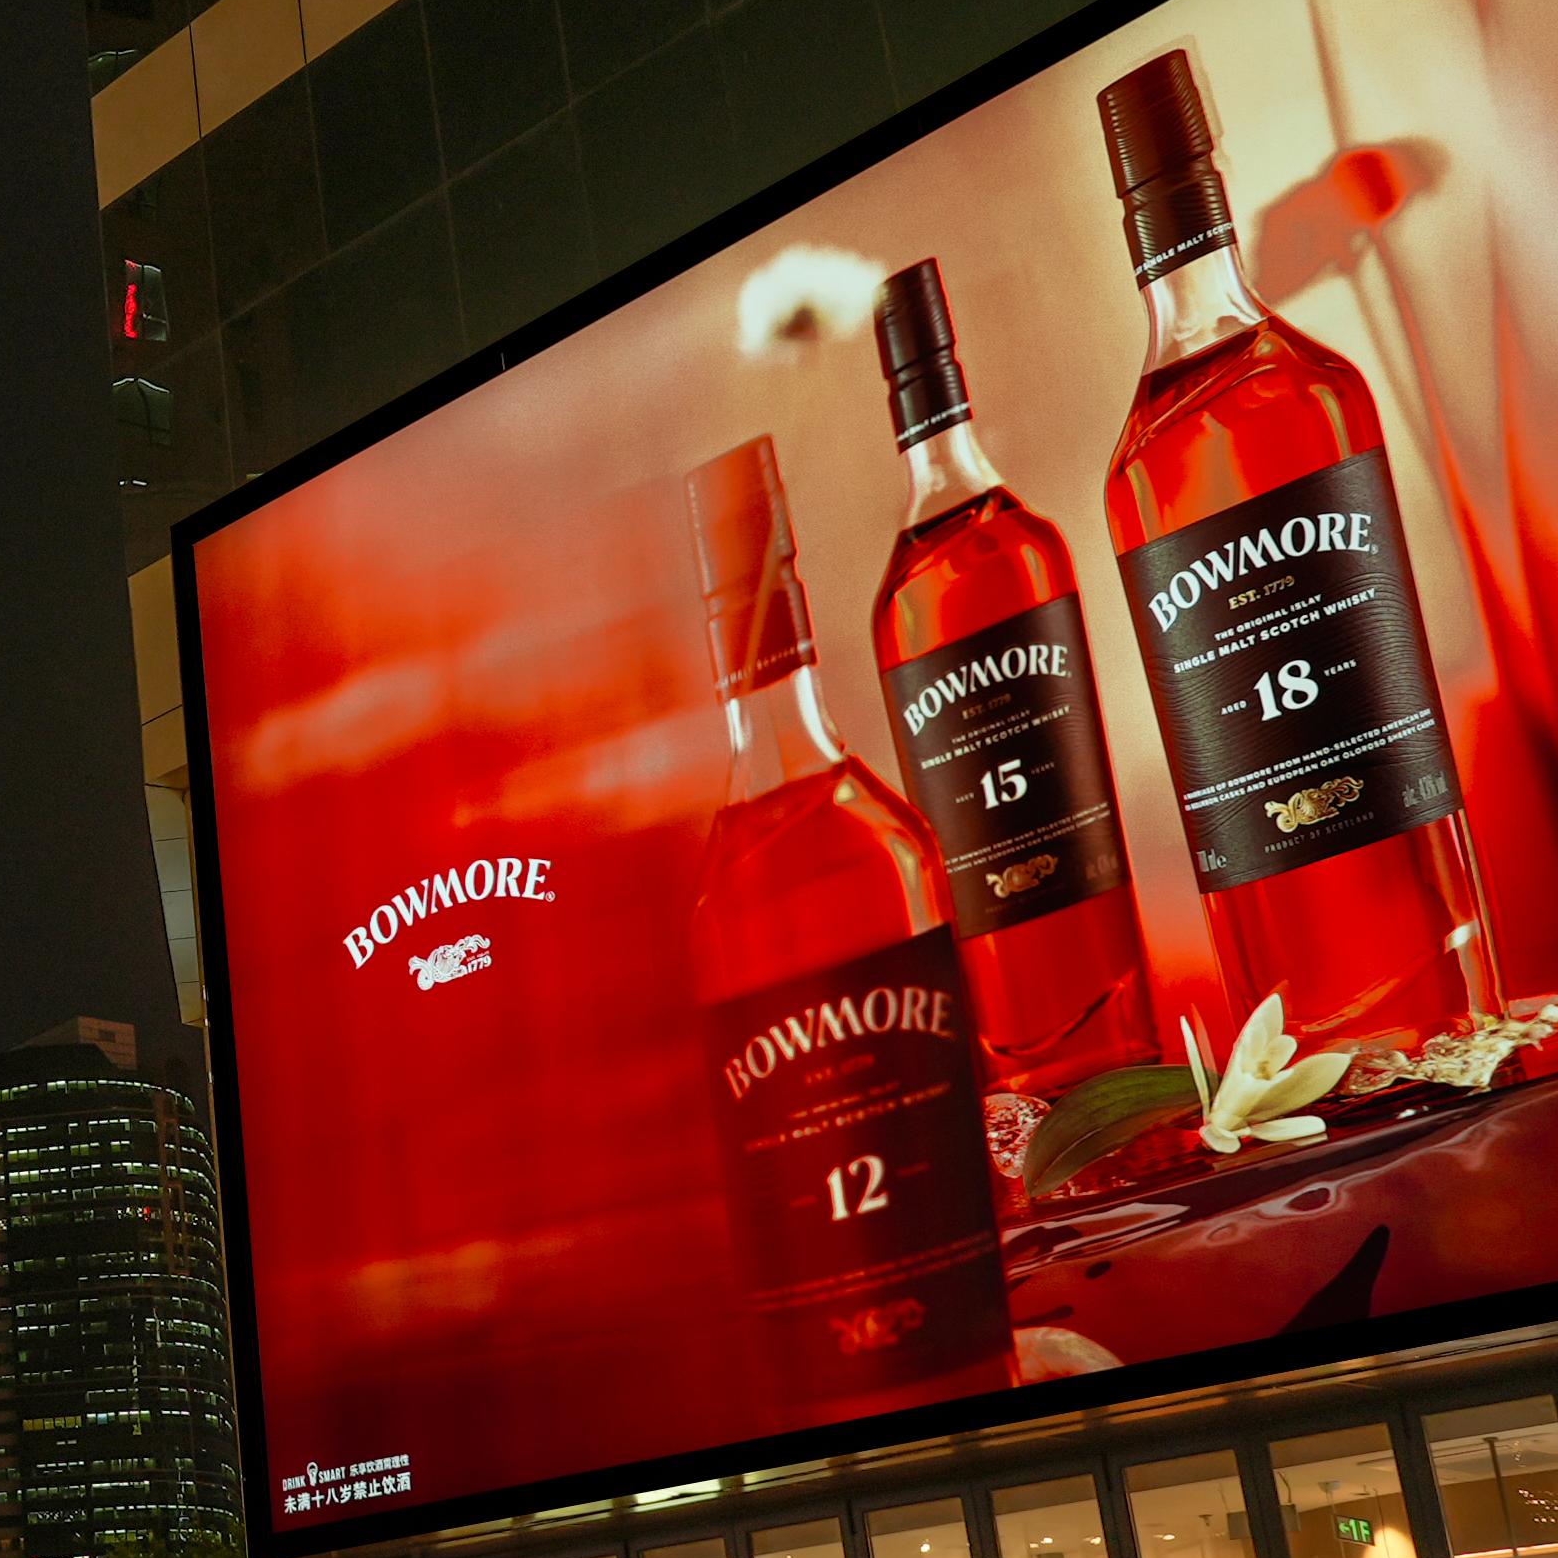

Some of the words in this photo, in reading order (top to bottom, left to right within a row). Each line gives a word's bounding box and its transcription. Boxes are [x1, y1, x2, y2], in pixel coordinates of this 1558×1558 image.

[1148, 512, 1372, 633] BOWMORE
[1228, 590, 1261, 610] EST.
[1263, 575, 1295, 598] 1779
[1173, 649, 1216, 674] SINGLE
[1218, 635, 1256, 658] MALT
[1260, 611, 1321, 642] SCOTCH
[1323, 587, 1377, 618] WHISKY
[1214, 629, 1235, 641] THE
[1236, 608, 1288, 634] ORIGINAL
[1289, 593, 1322, 615] ISLAY
[903, 644, 1068, 737] BOWMORE
[1221, 700, 1247, 716] AGED
[1253, 659, 1319, 722] 18
[1324, 659, 1357, 677] YEARS
[954, 740, 982, 757] MALT
[985, 722, 1030, 745] SCOTCH
[1216, 781, 1228, 793] OF
[1228, 766, 1272, 789] BOWMORE
[1273, 757, 1301, 774] FROM
[1302, 728, 1380, 762] HAND-SELECTED
[1246, 781, 1266, 794] AND
[1268, 763, 1319, 787] EUROPEAN
[1320, 754, 1340, 768] OAK
[1342, 738, 1386, 760] OLOROSO
[980, 759, 1028, 810] 15
[343, 857, 552, 970] BOWMORE
[726, 986, 956, 1100] BOWMORE
[827, 1154, 889, 1221] 12
[282, 1475, 306, 1492] DRINK
[318, 1466, 346, 1483] SMART
[284, 1472, 412, 1514] 未满十八岁禁止饮酒
